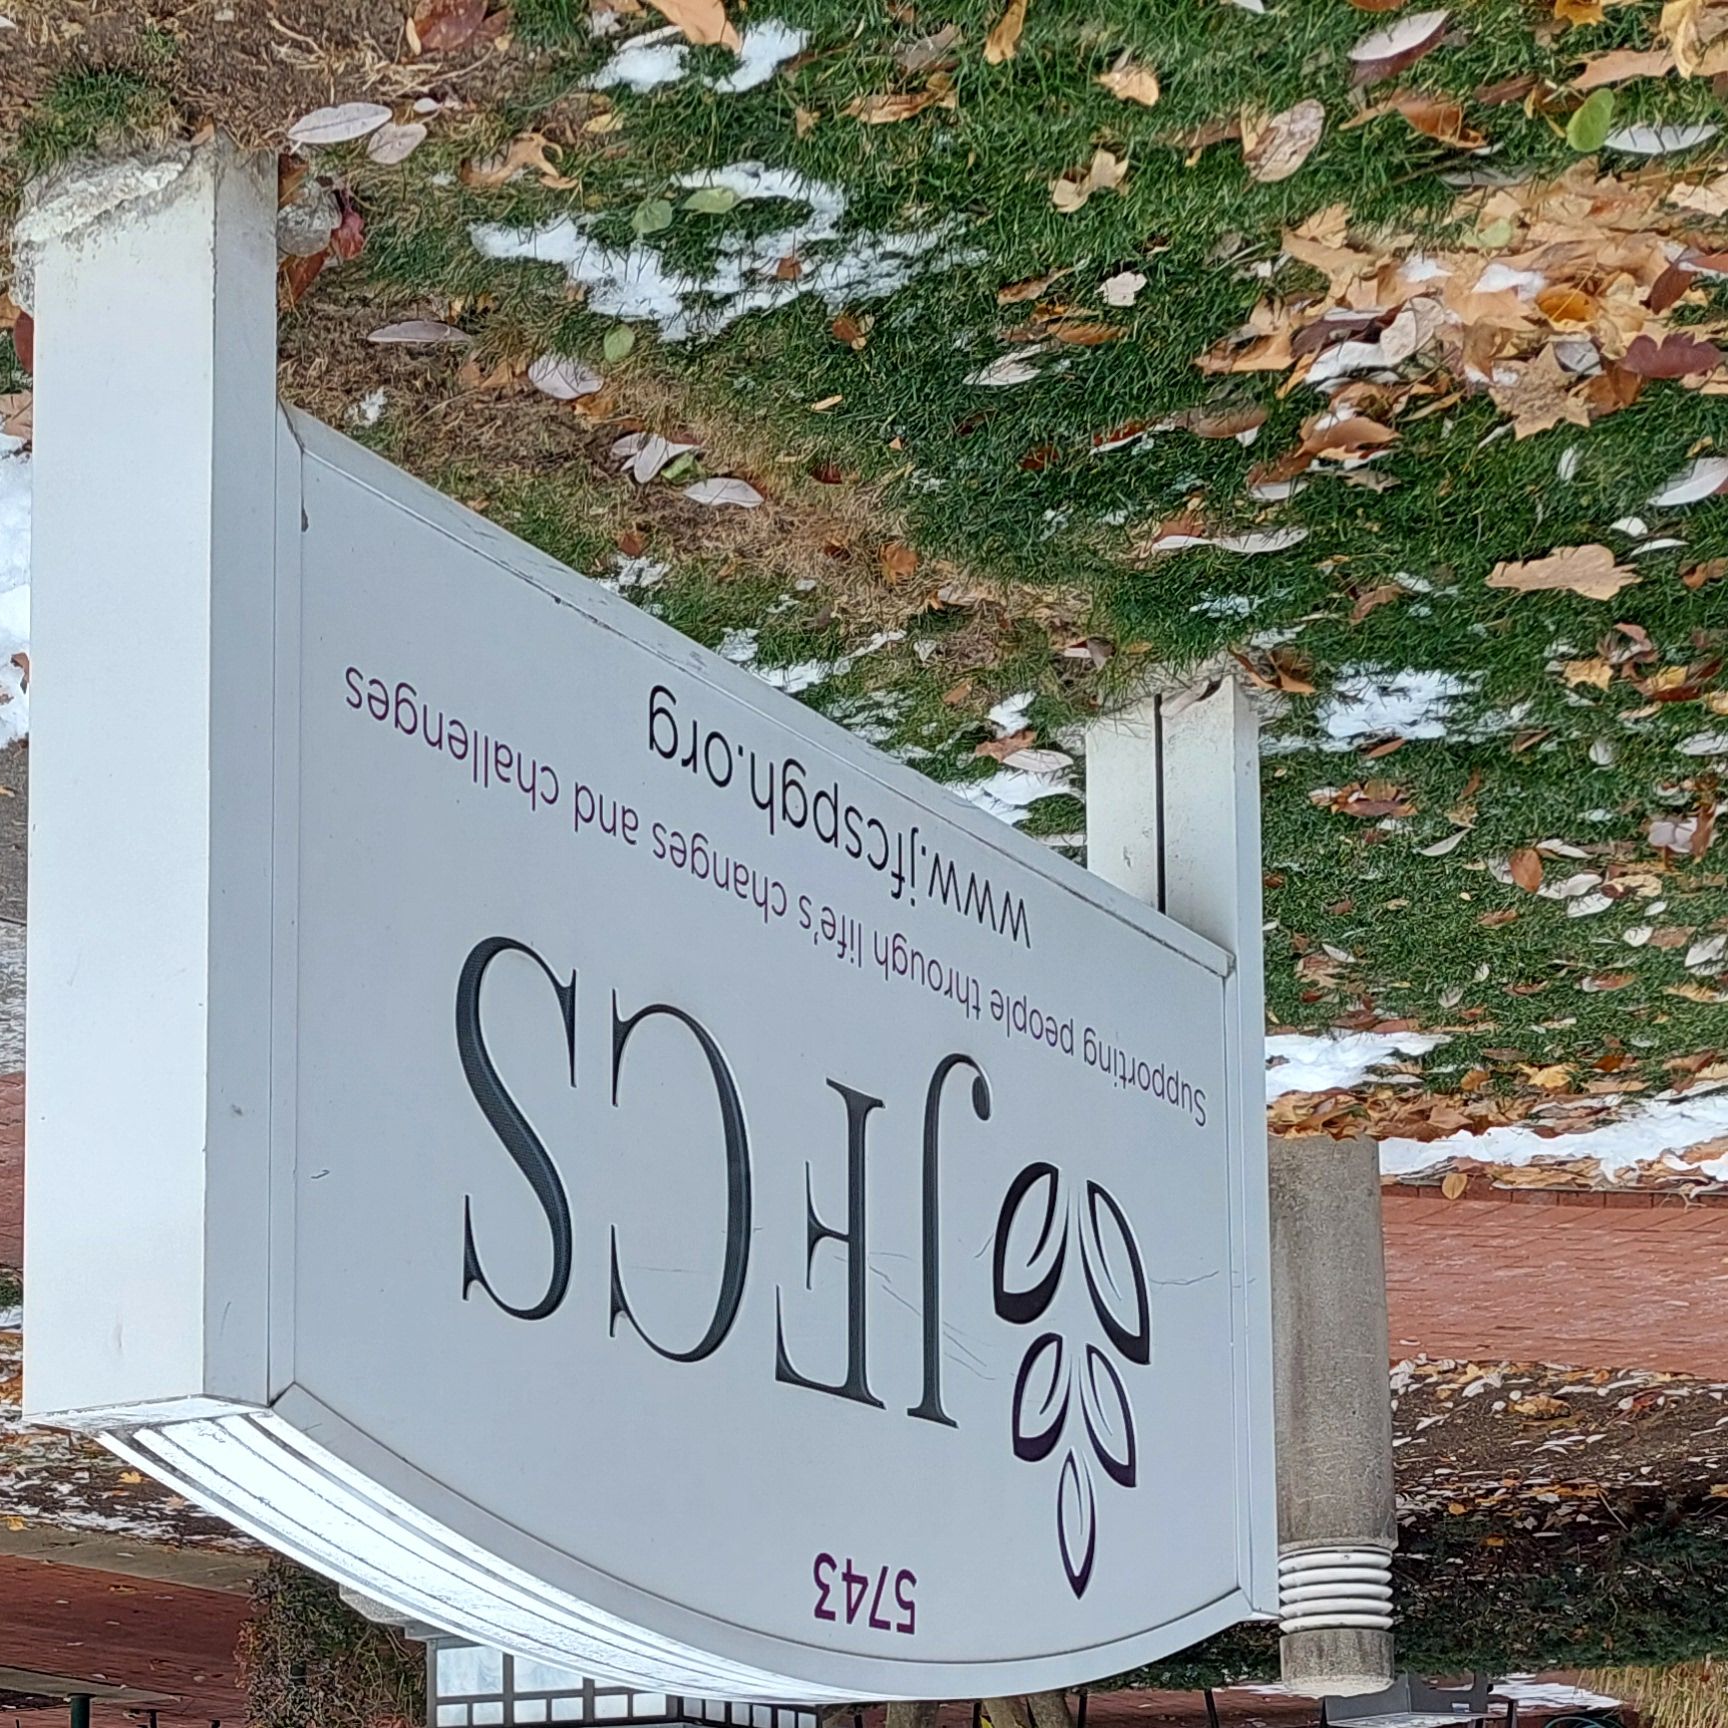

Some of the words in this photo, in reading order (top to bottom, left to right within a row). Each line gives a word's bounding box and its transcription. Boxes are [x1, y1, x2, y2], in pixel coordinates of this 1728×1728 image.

[344, 666, 560, 812] challenges
[573, 782, 640, 847] and
[648, 684, 1031, 950] www.jfcspgh.org
[652, 822, 788, 924] changes
[798, 894, 863, 969] life's
[873, 930, 981, 1021] through
[990, 989, 1075, 1058] people
[1083, 1027, 1208, 1128] Supporting
[455, 936, 992, 1430] JFCS
[813, 1553, 917, 1635] 5743
